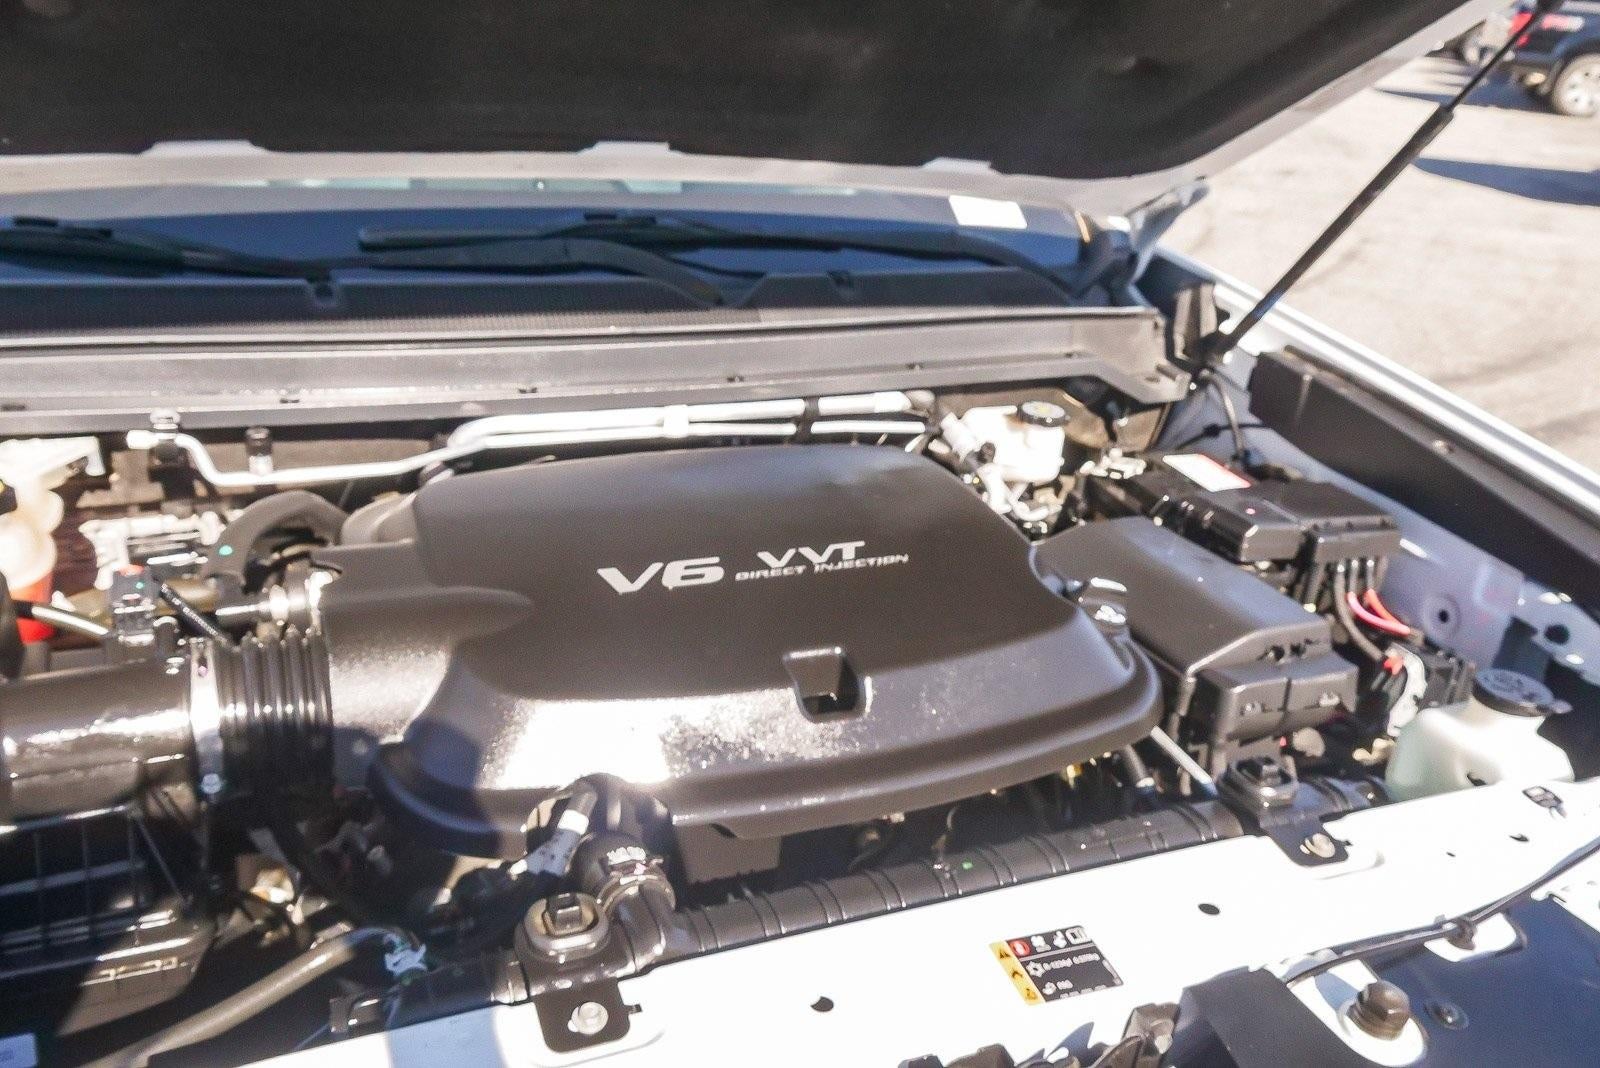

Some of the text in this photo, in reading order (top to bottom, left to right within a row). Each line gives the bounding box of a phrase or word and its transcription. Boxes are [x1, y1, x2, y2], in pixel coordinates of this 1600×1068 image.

[597, 541, 866, 594] V6 VVT
[735, 553, 909, 581] DIRECT INJECTION
